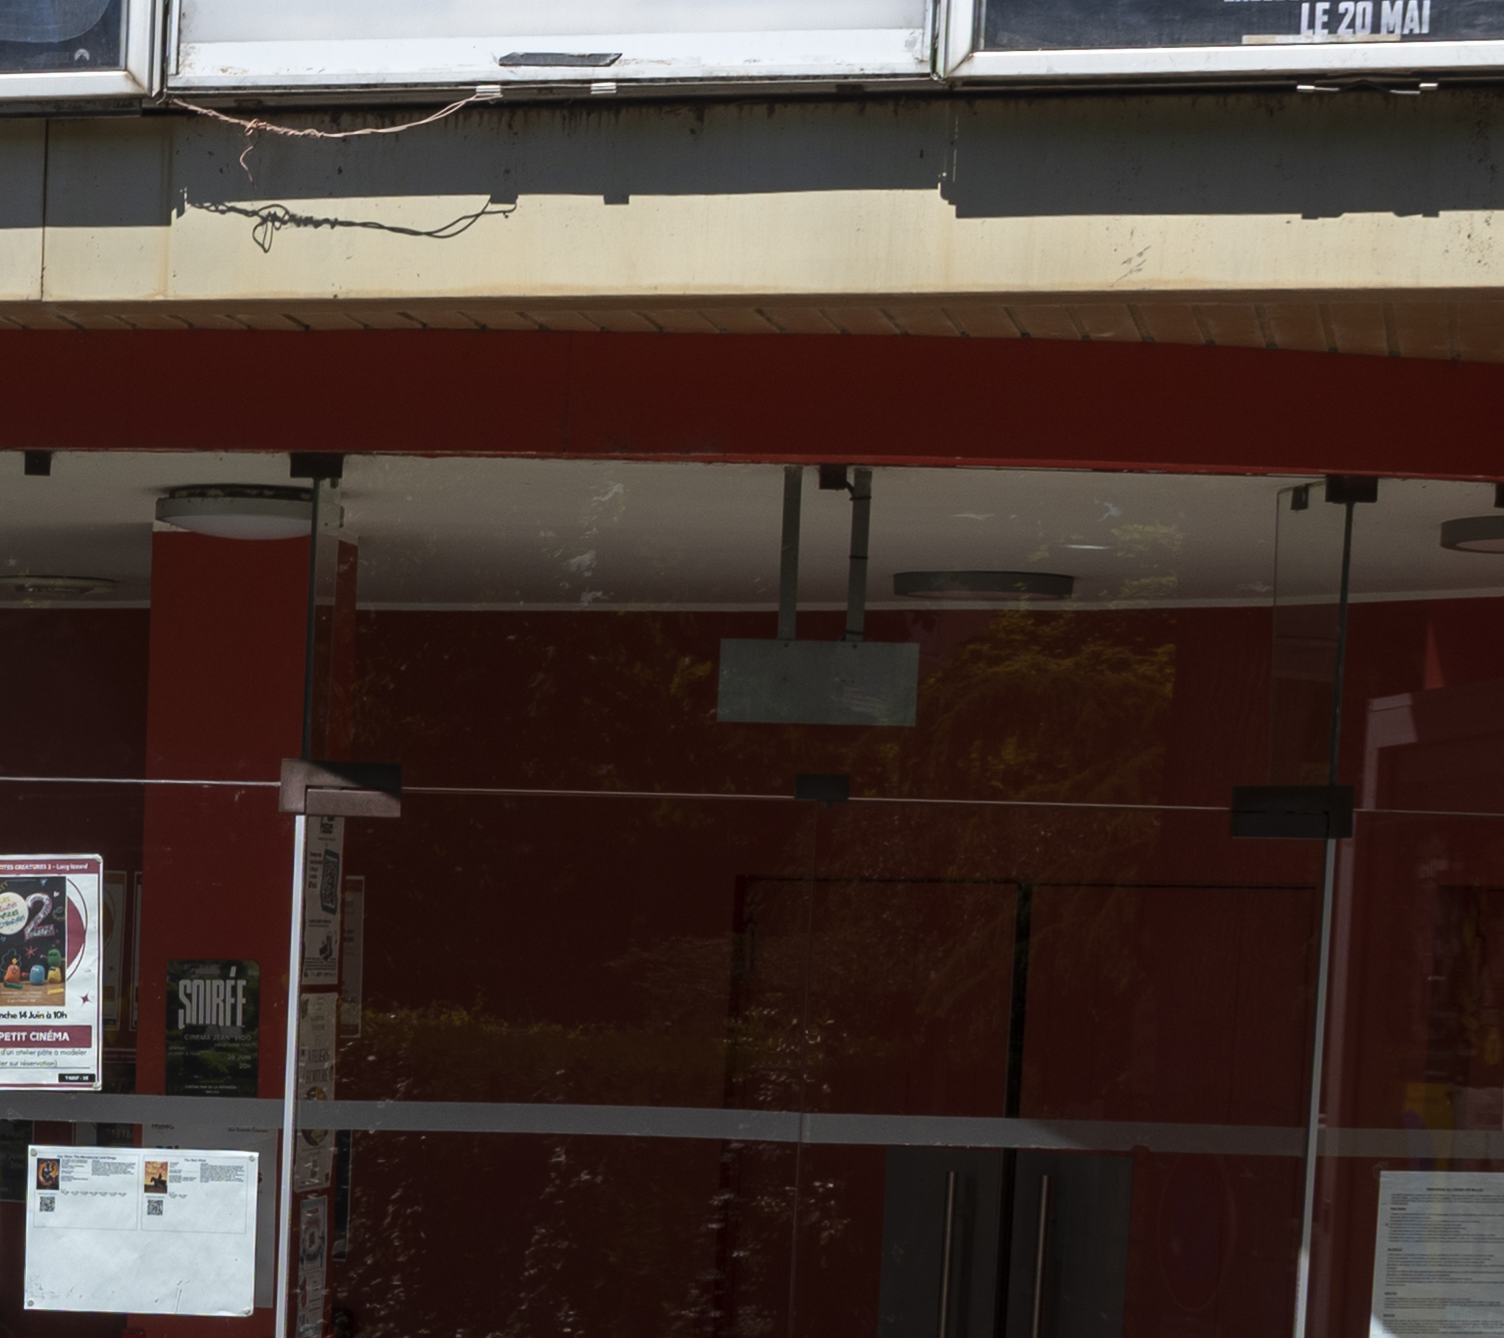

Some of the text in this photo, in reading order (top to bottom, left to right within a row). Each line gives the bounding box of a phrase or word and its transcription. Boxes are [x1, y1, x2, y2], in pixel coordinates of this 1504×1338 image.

[1300, 2, 1331, 34] LE
[1338, 2, 1373, 35] 20
[178, 966, 246, 1030] SOIRÉE
[54, 1011, 67, 1019] 10h
[30, 1029, 69, 1041] CINÉMA
